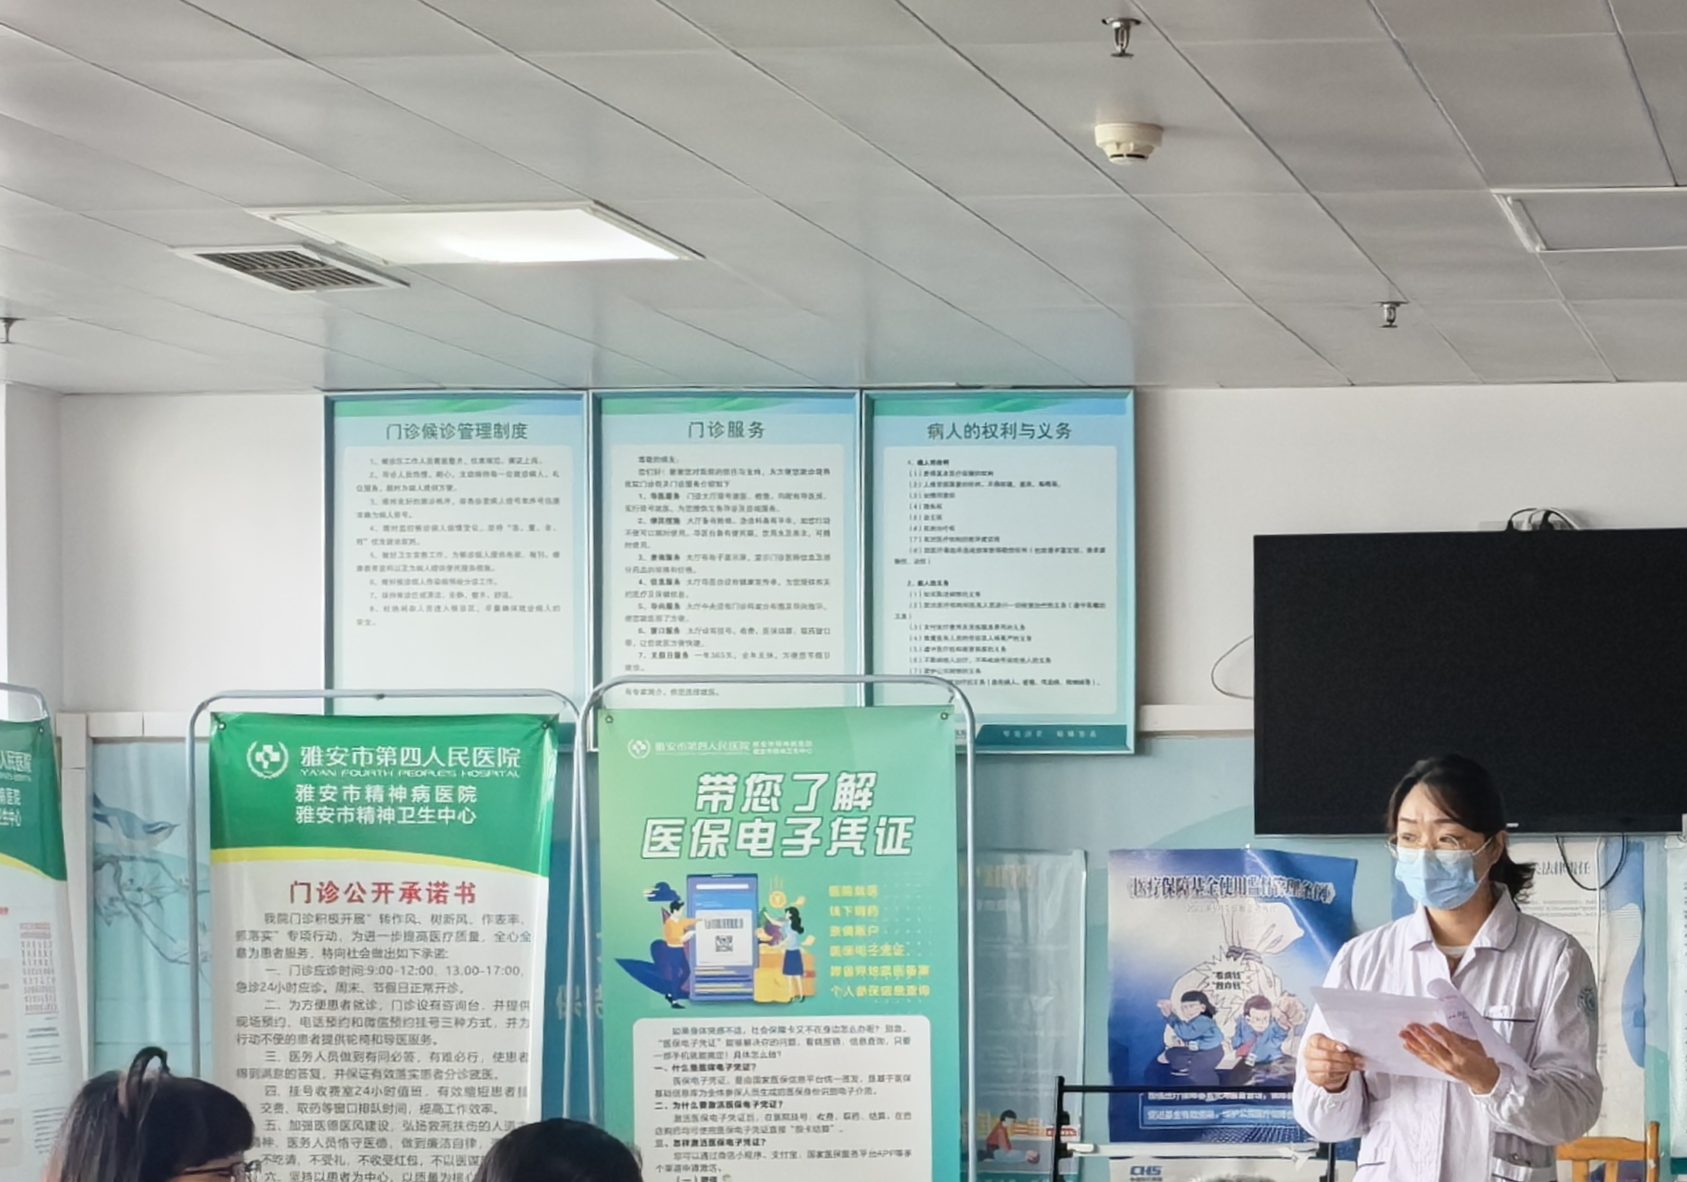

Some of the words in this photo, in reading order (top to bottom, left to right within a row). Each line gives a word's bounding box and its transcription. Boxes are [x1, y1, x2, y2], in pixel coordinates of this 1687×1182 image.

[386, 422, 529, 441] 门诊候诊管理制度
[688, 421, 766, 439] 门诊服务
[927, 422, 1072, 440] 病人的权利与义务
[300, 746, 521, 768] 雅安市第四人民医院
[296, 785, 478, 802] 雅安市精神病医院
[695, 772, 878, 813] 带您了解
[296, 807, 477, 824] 雅安市精神卫生中心
[640, 816, 916, 859] 医保电子凭证
[290, 881, 477, 904] 门诊公开承诺书
